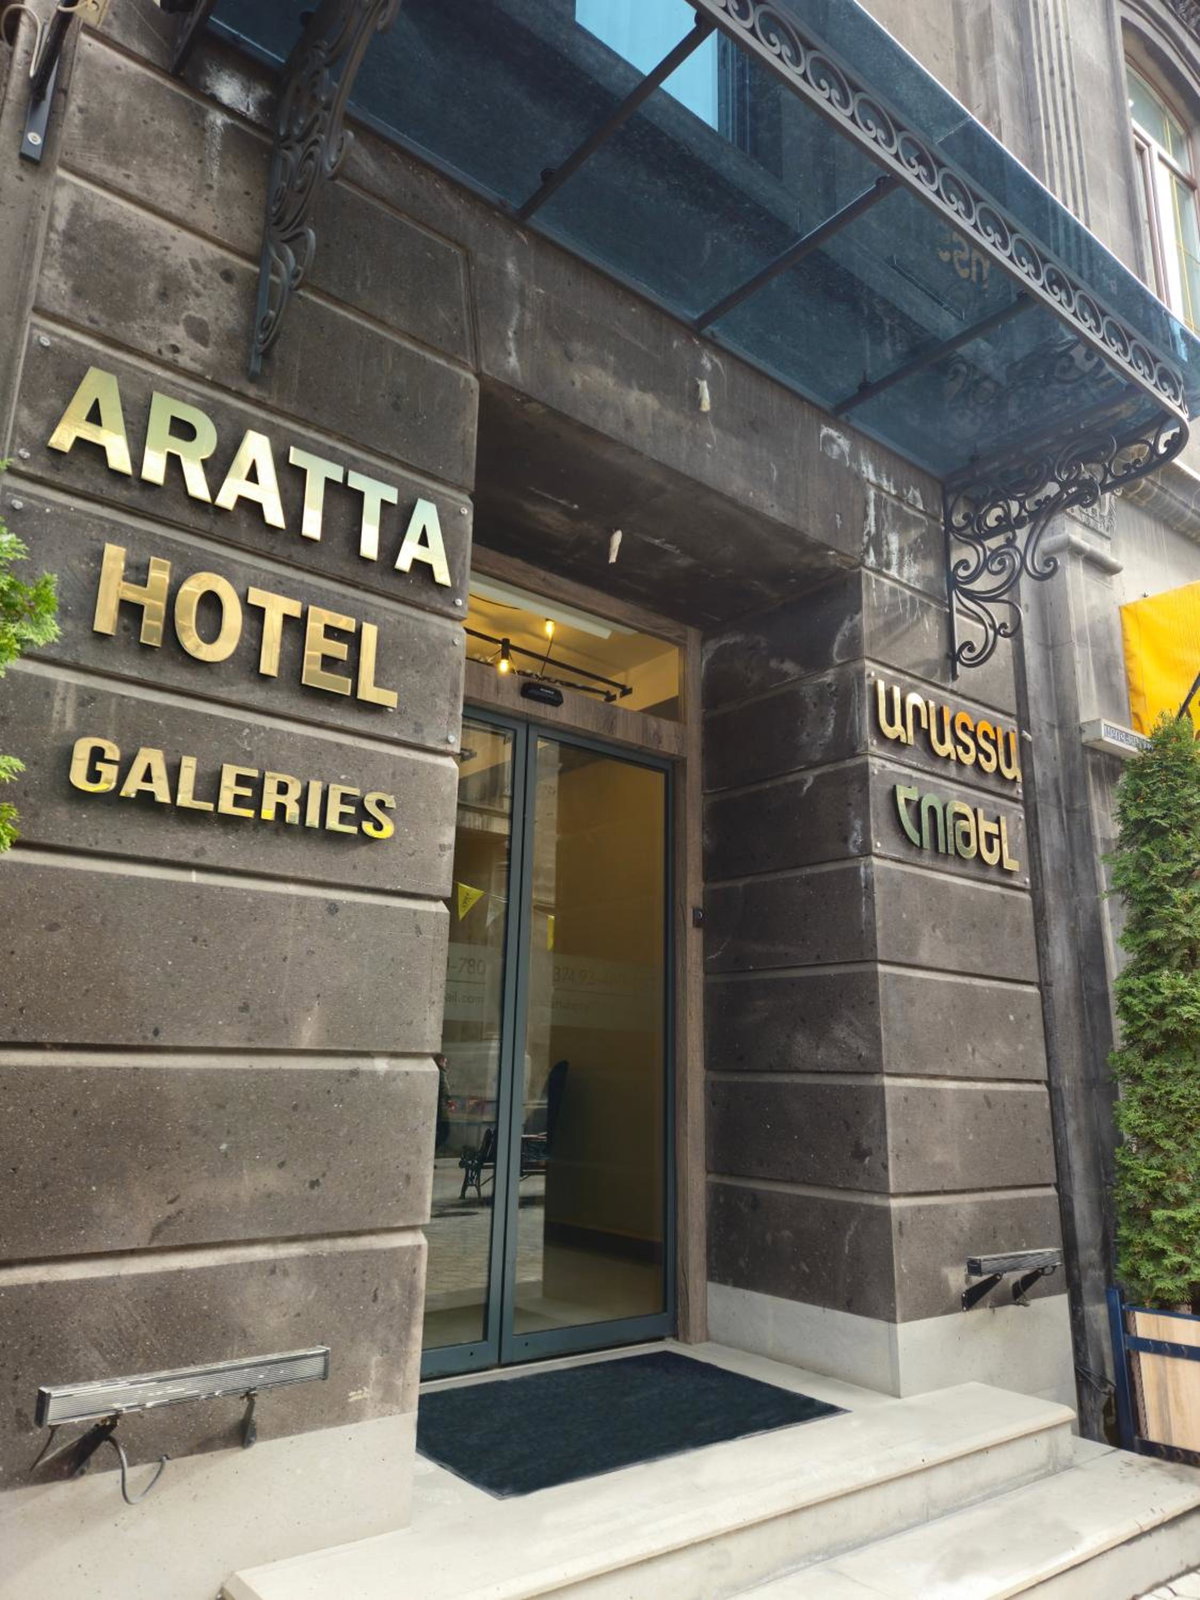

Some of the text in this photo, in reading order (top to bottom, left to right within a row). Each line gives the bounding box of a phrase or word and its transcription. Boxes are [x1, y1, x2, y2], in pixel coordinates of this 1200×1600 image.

[48, 366, 452, 587] ARATTA
[93, 543, 398, 708] HOTEL
[69, 737, 396, 840] GALERIES
